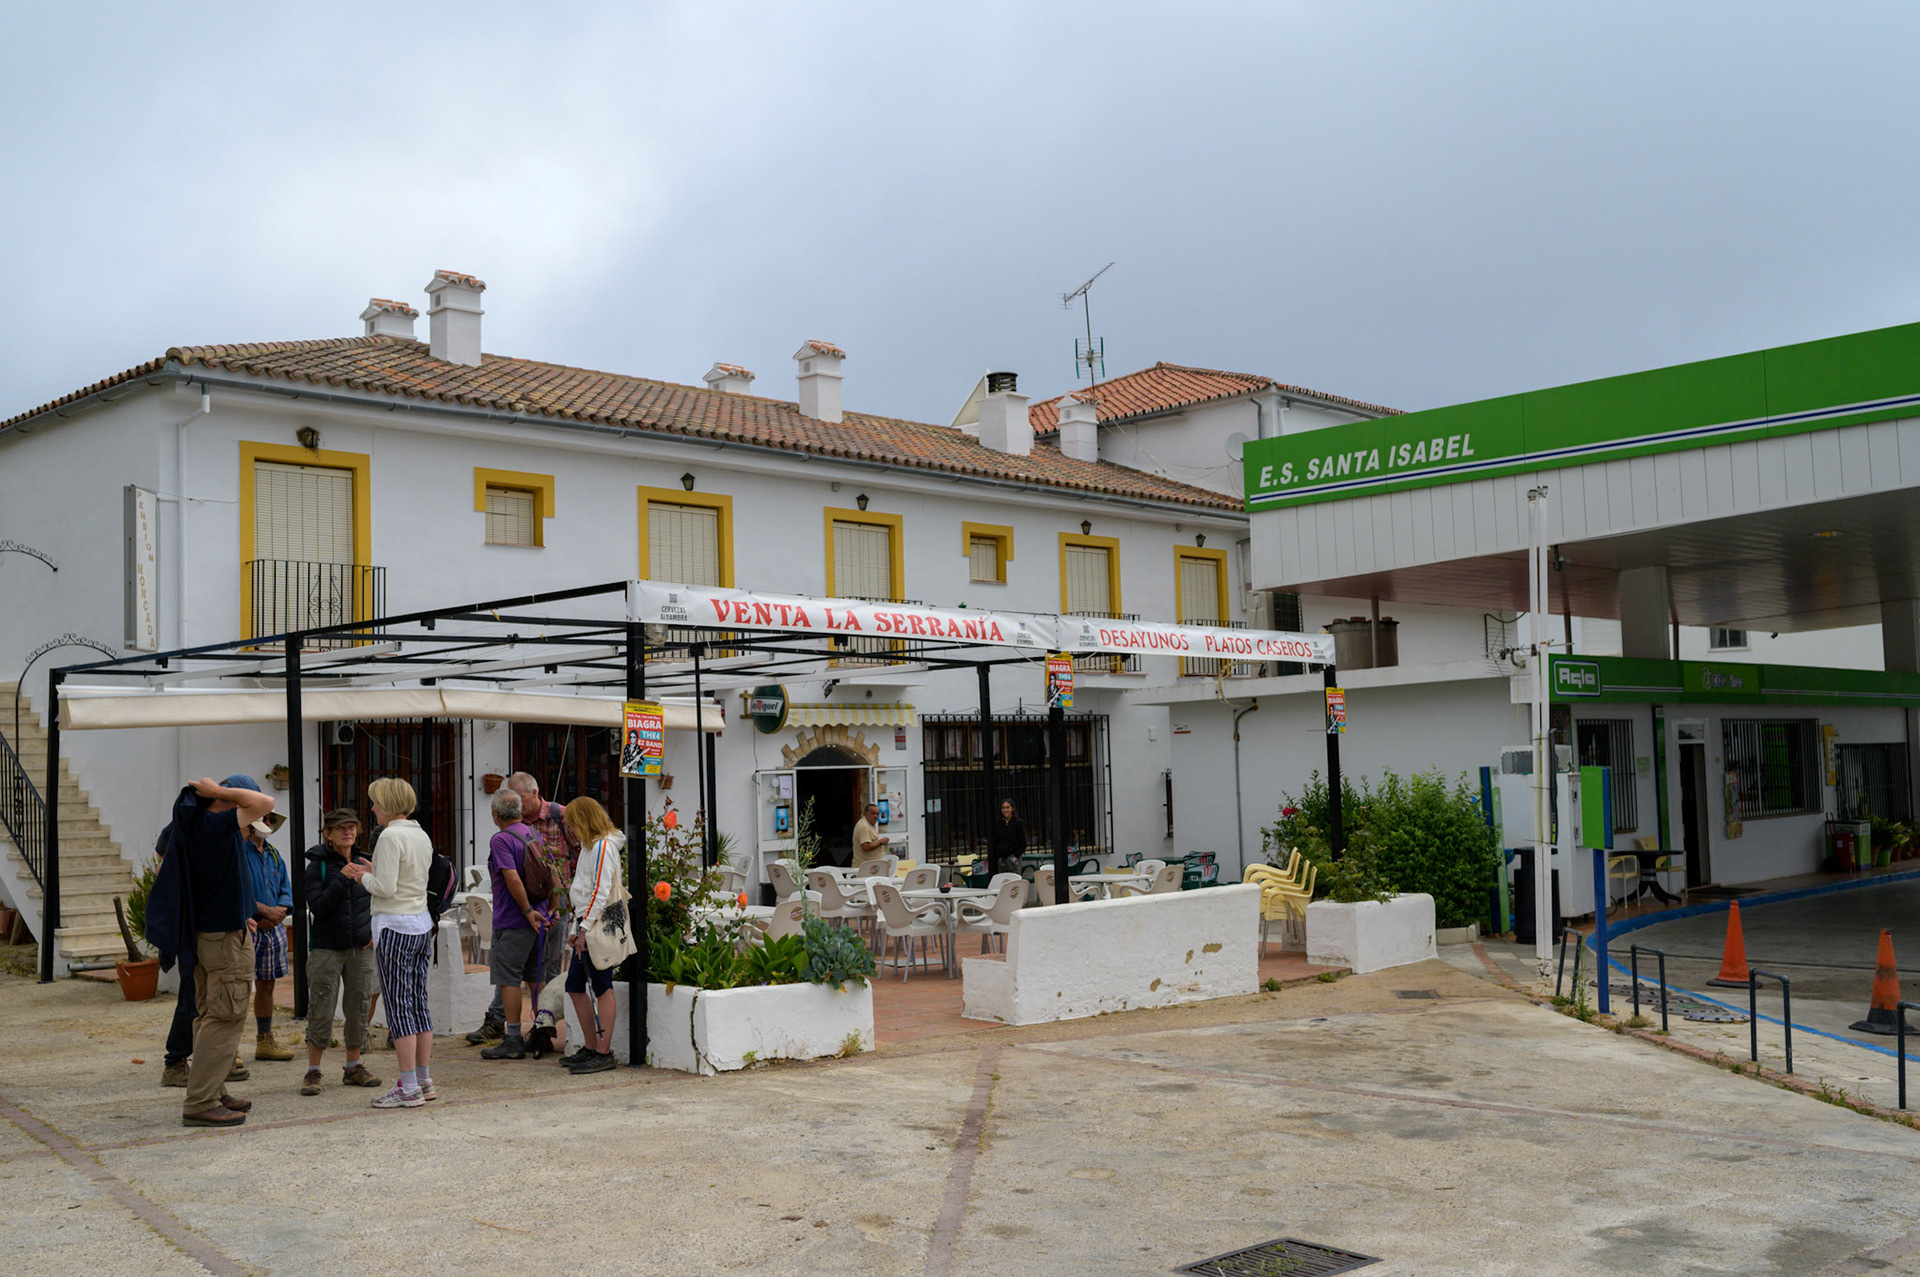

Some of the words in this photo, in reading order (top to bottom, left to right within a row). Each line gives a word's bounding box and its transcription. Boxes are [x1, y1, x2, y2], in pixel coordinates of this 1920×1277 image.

[1259, 462, 1299, 488] E.S.
[1306, 448, 1380, 481] SANTA
[1388, 433, 1475, 468] ISABEL
[137, 490, 154, 562] PENSION
[137, 563, 156, 649] MONCADA
[709, 598, 812, 628] VENTA
[823, 607, 862, 631] LA
[873, 611, 1005, 643] SERRANÍA
[1099, 628, 1189, 651] DESAYUNOS
[1204, 635, 1252, 655] PLATOS
[1256, 639, 1313, 658] CASEROS
[627, 719, 662, 730] BIAGRA
